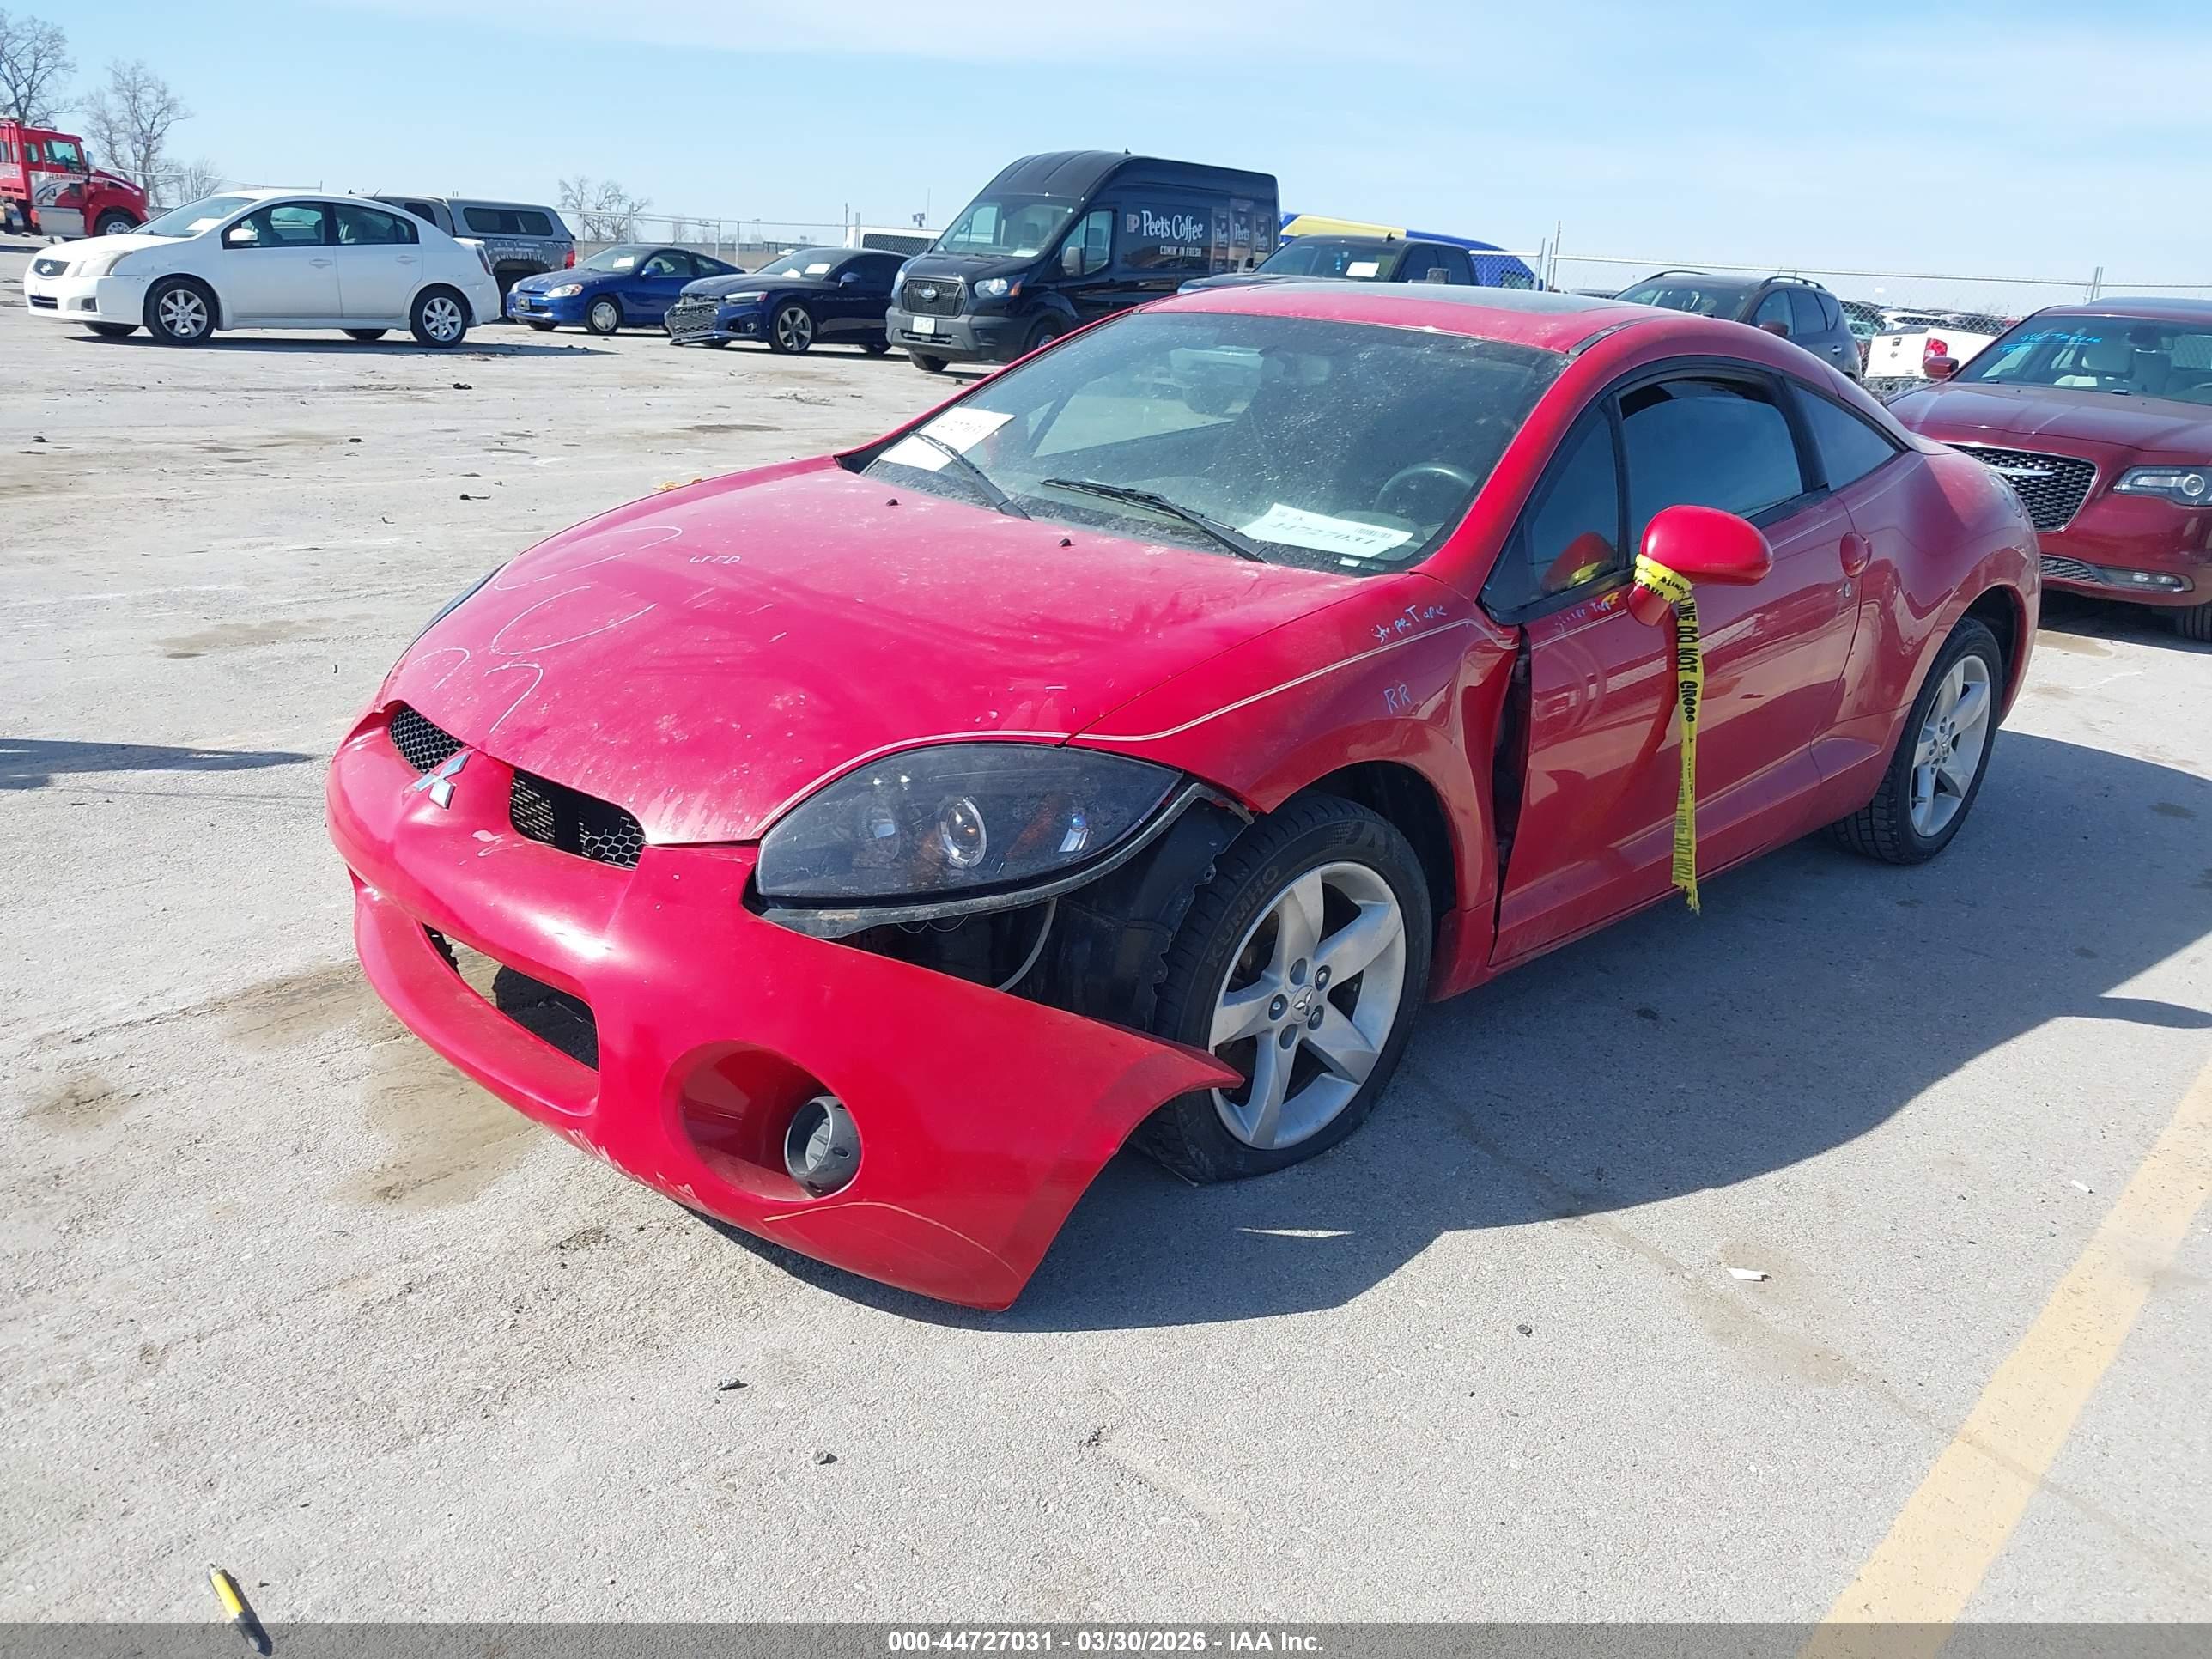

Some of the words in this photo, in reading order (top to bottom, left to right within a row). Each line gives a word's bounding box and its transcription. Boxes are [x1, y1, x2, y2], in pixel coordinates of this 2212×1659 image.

[1141, 210, 1170, 238] Peet's
[1172, 215, 1204, 243] Coffee
[1186, 246, 1202, 257] FRESH
[1677, 625, 1699, 643] DO
[1678, 648, 1698, 673] NOT
